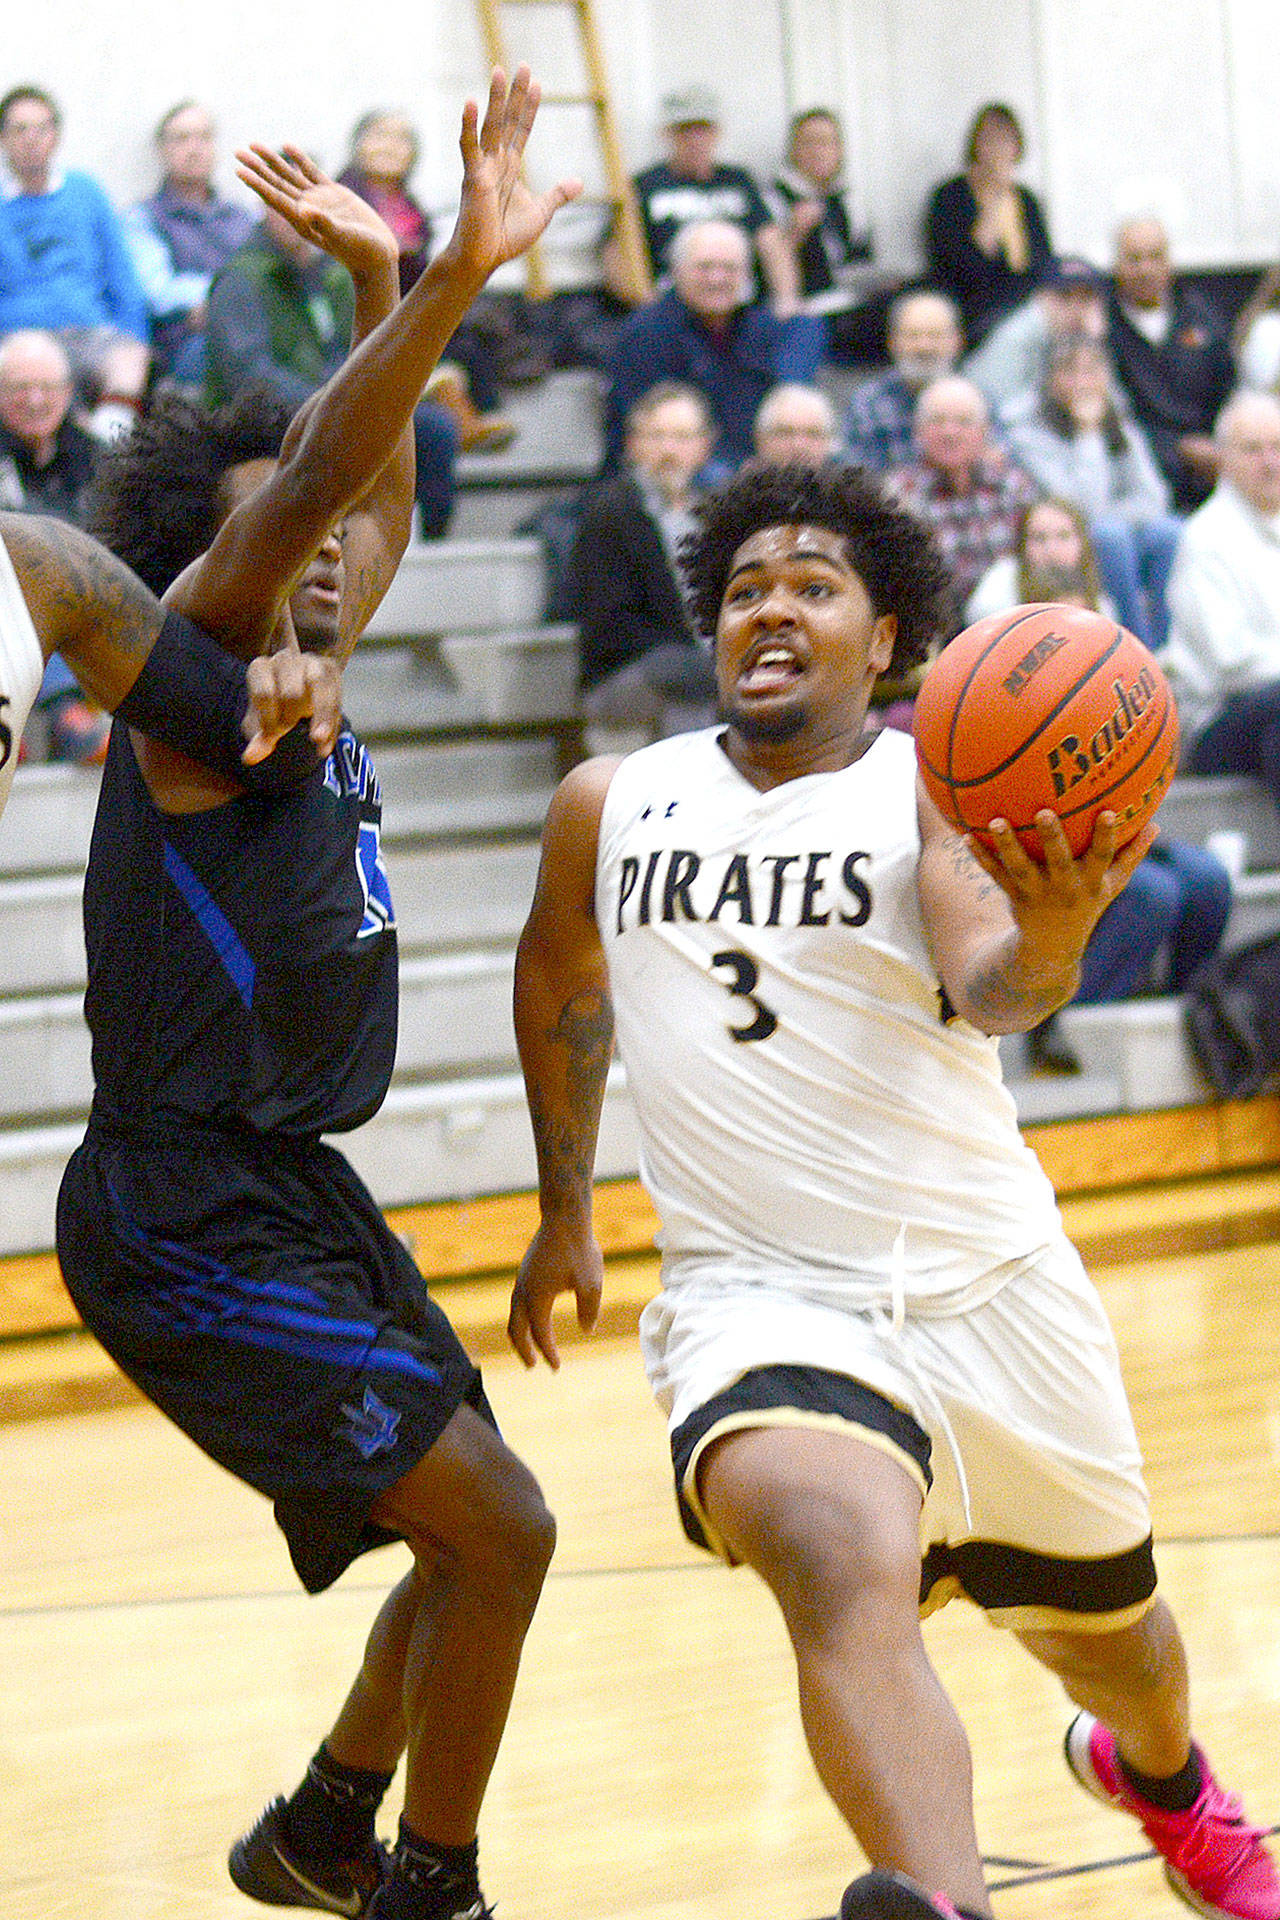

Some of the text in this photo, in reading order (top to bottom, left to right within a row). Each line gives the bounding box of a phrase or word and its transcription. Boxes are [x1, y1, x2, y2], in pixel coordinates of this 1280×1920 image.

[1047, 667, 1157, 799] Baden
[616, 850, 873, 935] PIRATES
[712, 950, 779, 1043] 3
